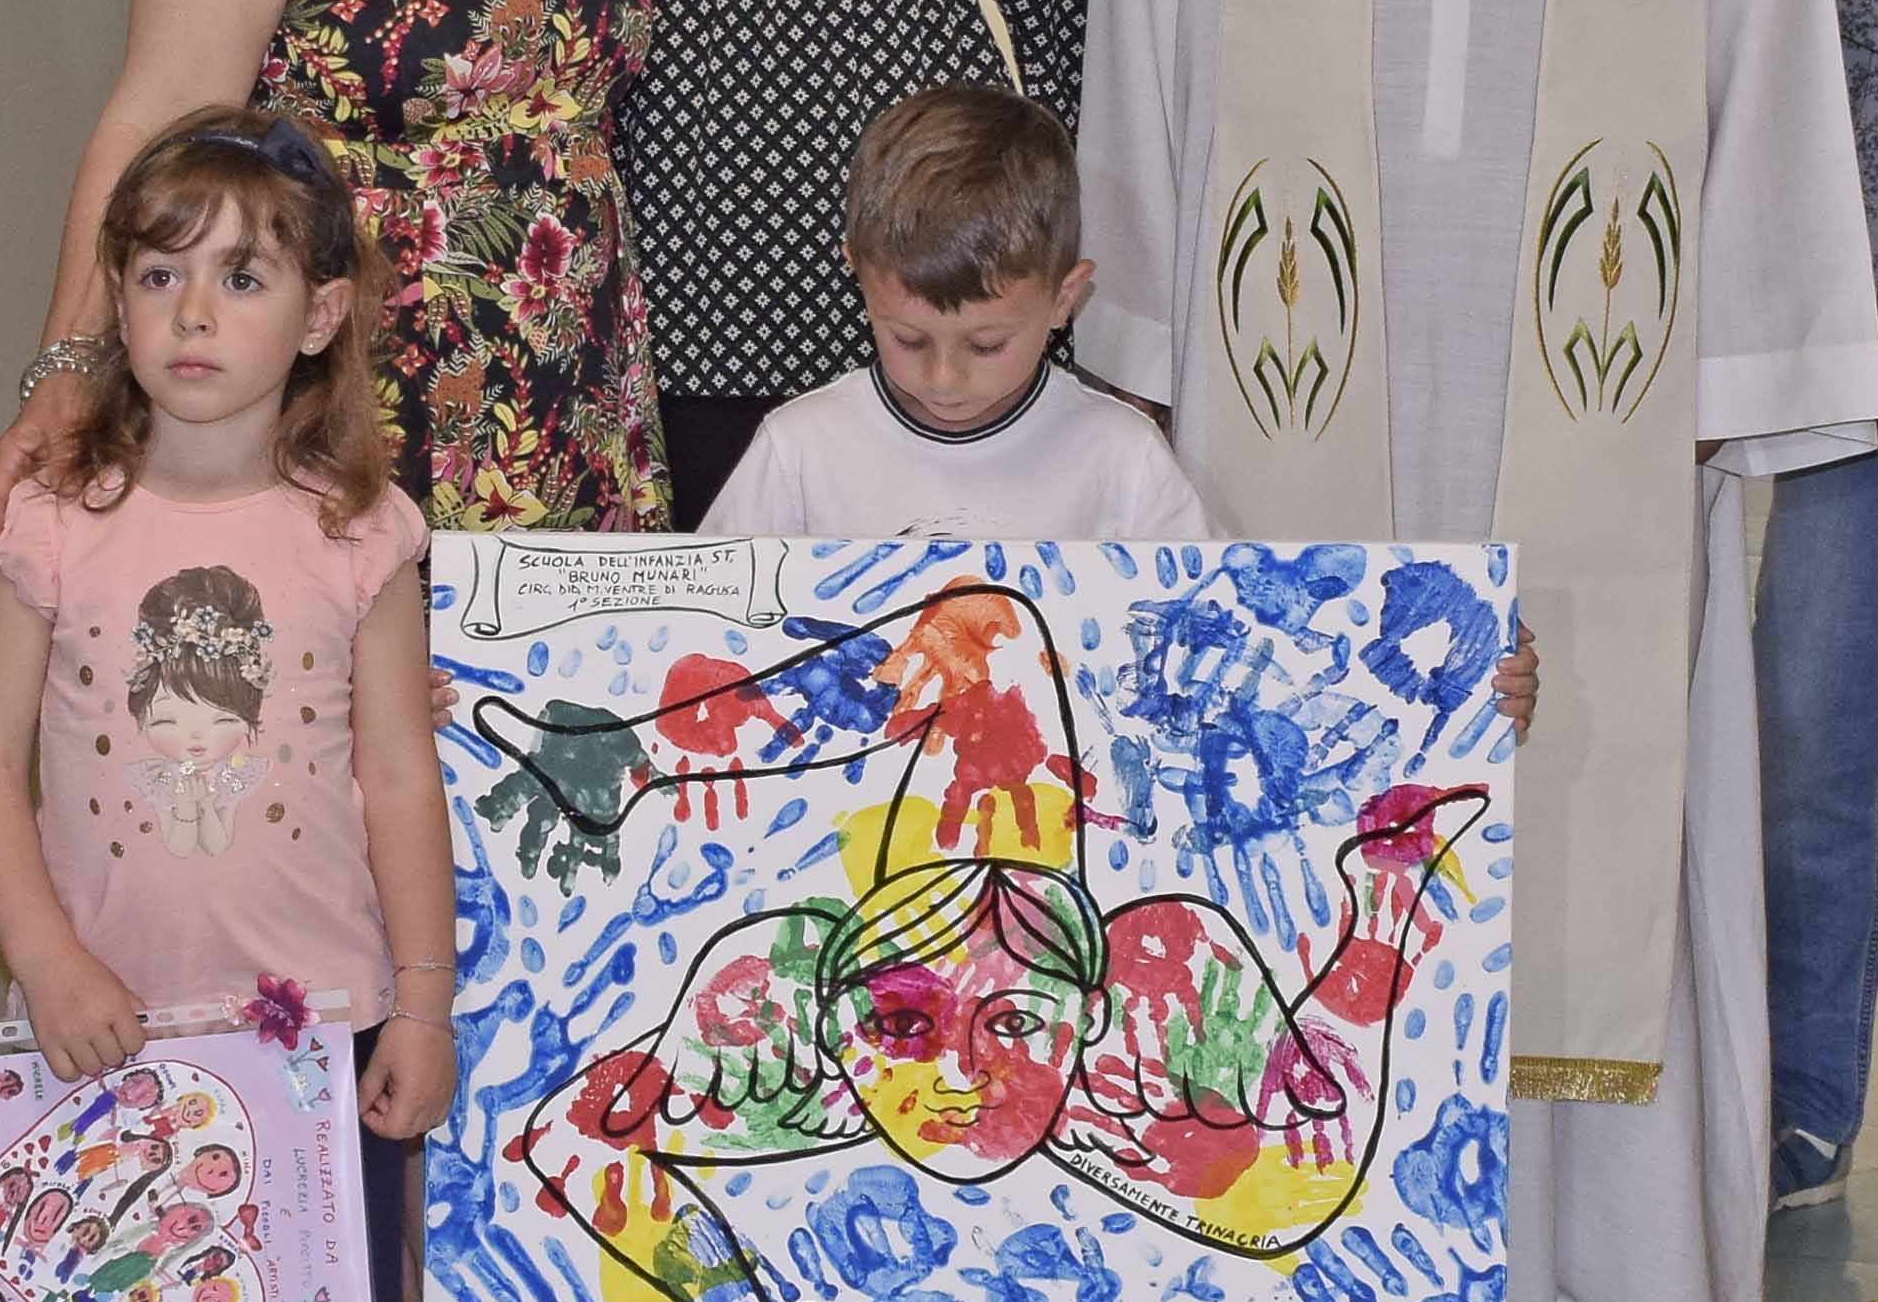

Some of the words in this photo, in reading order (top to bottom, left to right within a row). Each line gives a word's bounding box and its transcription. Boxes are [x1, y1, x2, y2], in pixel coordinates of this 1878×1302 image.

[518, 553, 585, 571] SCUOLA
[598, 552, 704, 569] DELL'INFANZIA
[558, 567, 621, 584] "BRUNO
[632, 566, 708, 583] MUNARI"
[590, 594, 661, 608] SEZIONE
[664, 584, 677, 595] DI
[686, 583, 740, 597] RAGUSA
[262, 1158, 272, 1185] DAI
[292, 1148, 308, 1214] LUCREZIA
[315, 1120, 336, 1224] REALIZZATO
[1070, 1152, 1179, 1222] DIVERSAMENTE
[1185, 1214, 1284, 1250] TRINACRIA
[325, 1239, 339, 1265] DA
